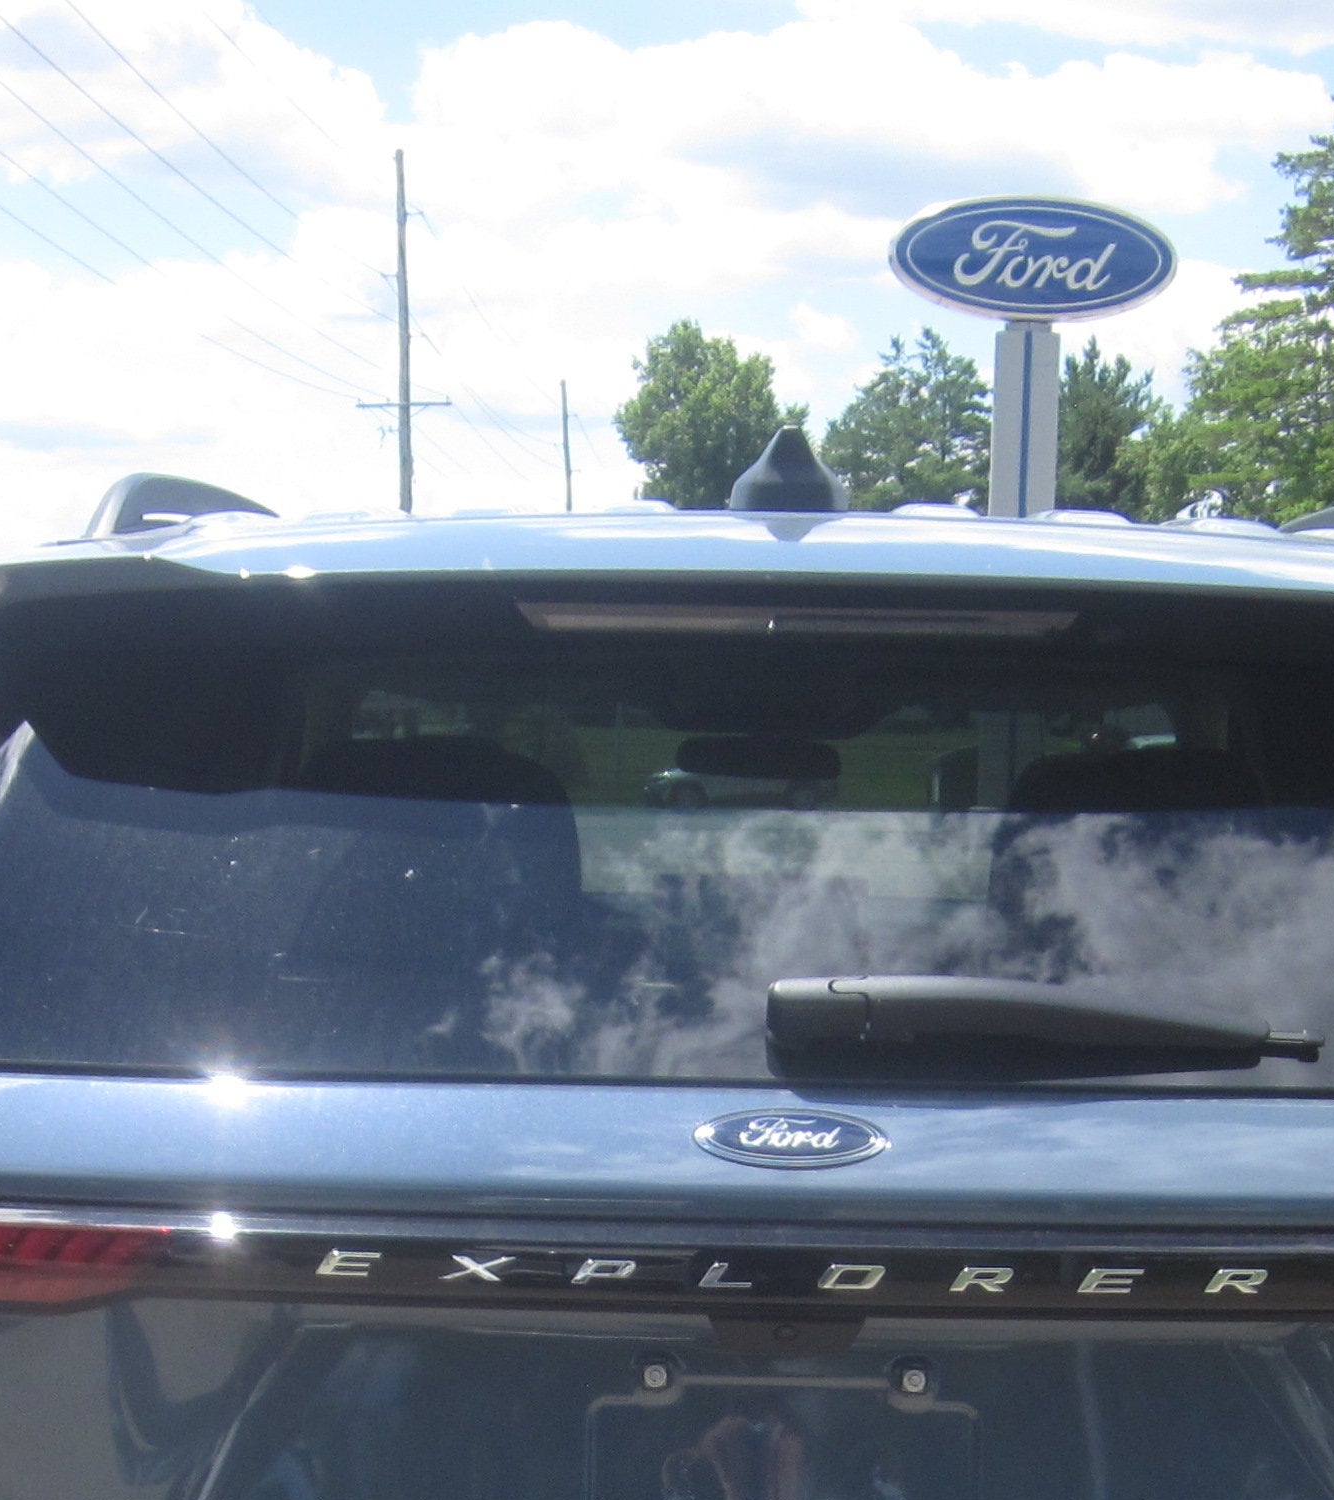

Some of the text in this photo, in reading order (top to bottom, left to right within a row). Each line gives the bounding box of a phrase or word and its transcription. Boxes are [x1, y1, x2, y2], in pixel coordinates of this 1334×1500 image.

[953, 219, 1116, 291] Ford
[739, 1116, 843, 1149] Ford
[315, 1247, 1269, 1294] EXPLORER
